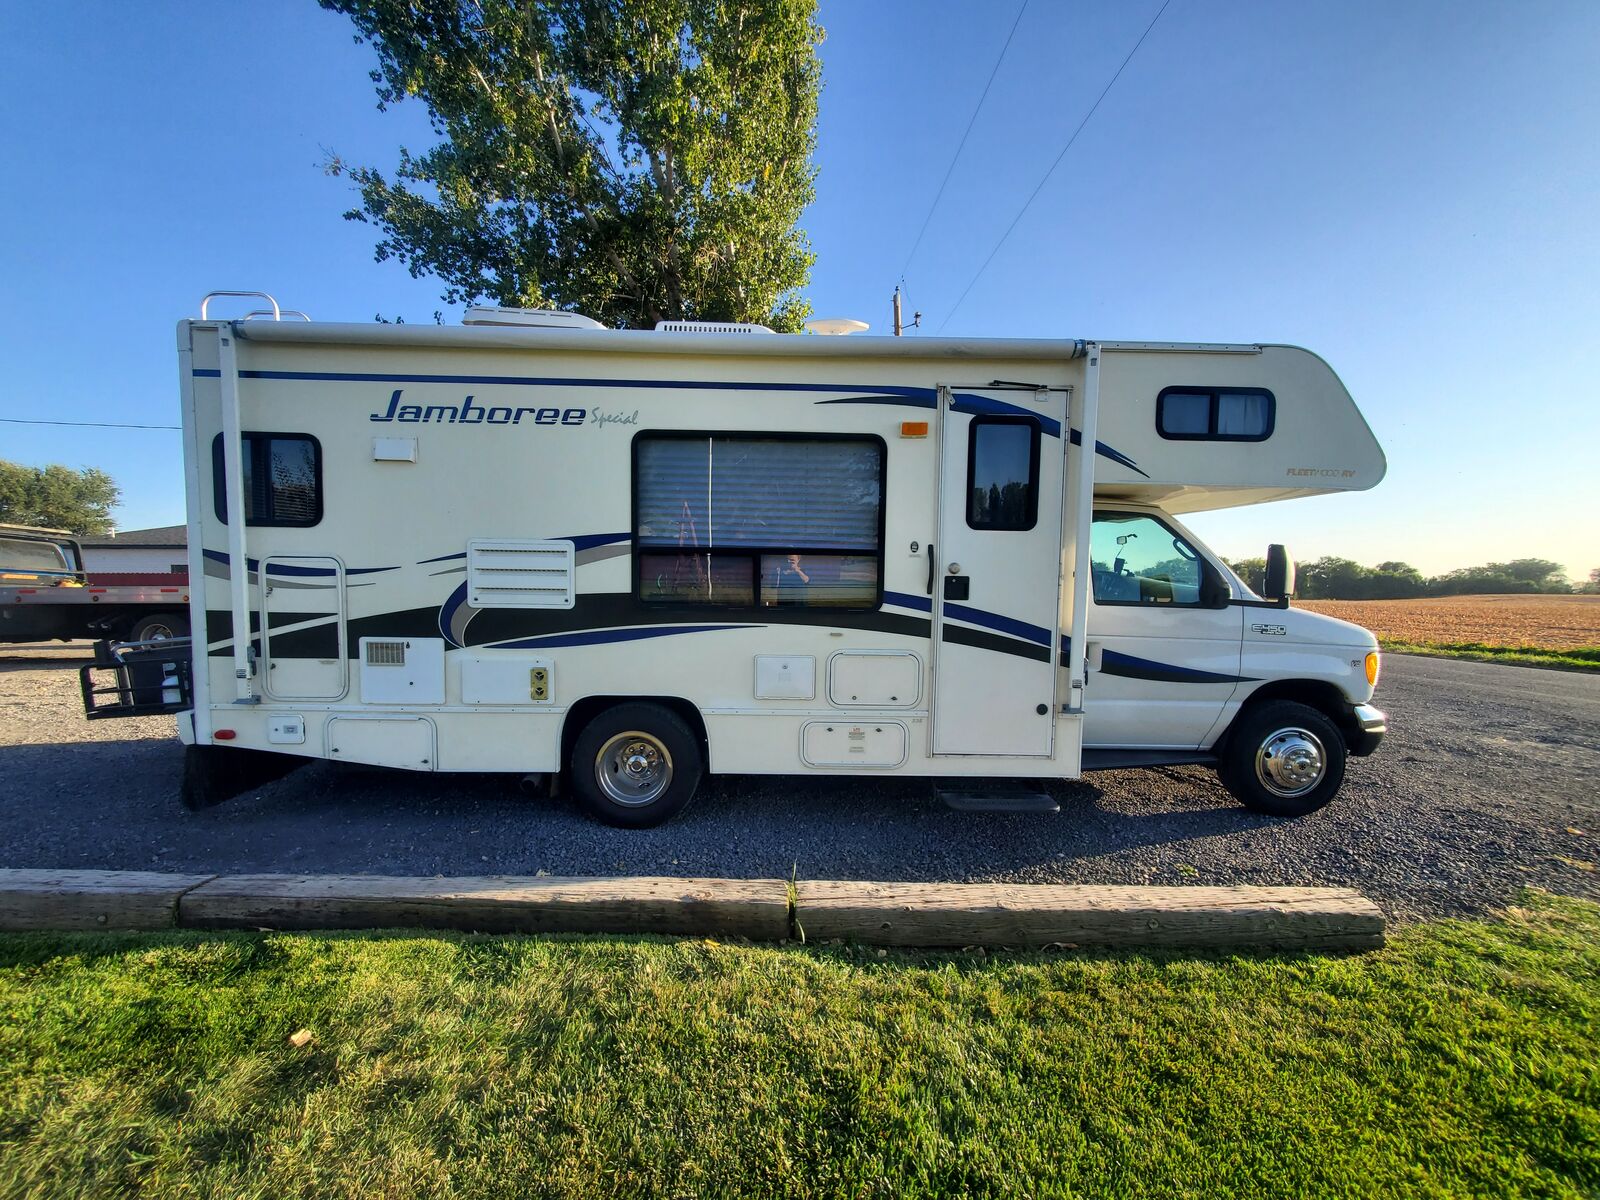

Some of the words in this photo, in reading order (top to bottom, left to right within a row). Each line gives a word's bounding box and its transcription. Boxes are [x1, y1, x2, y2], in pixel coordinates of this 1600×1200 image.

[370, 389, 587, 426] Jamboree
[590, 406, 639, 429] Special
[1252, 623, 1287, 634] E450
